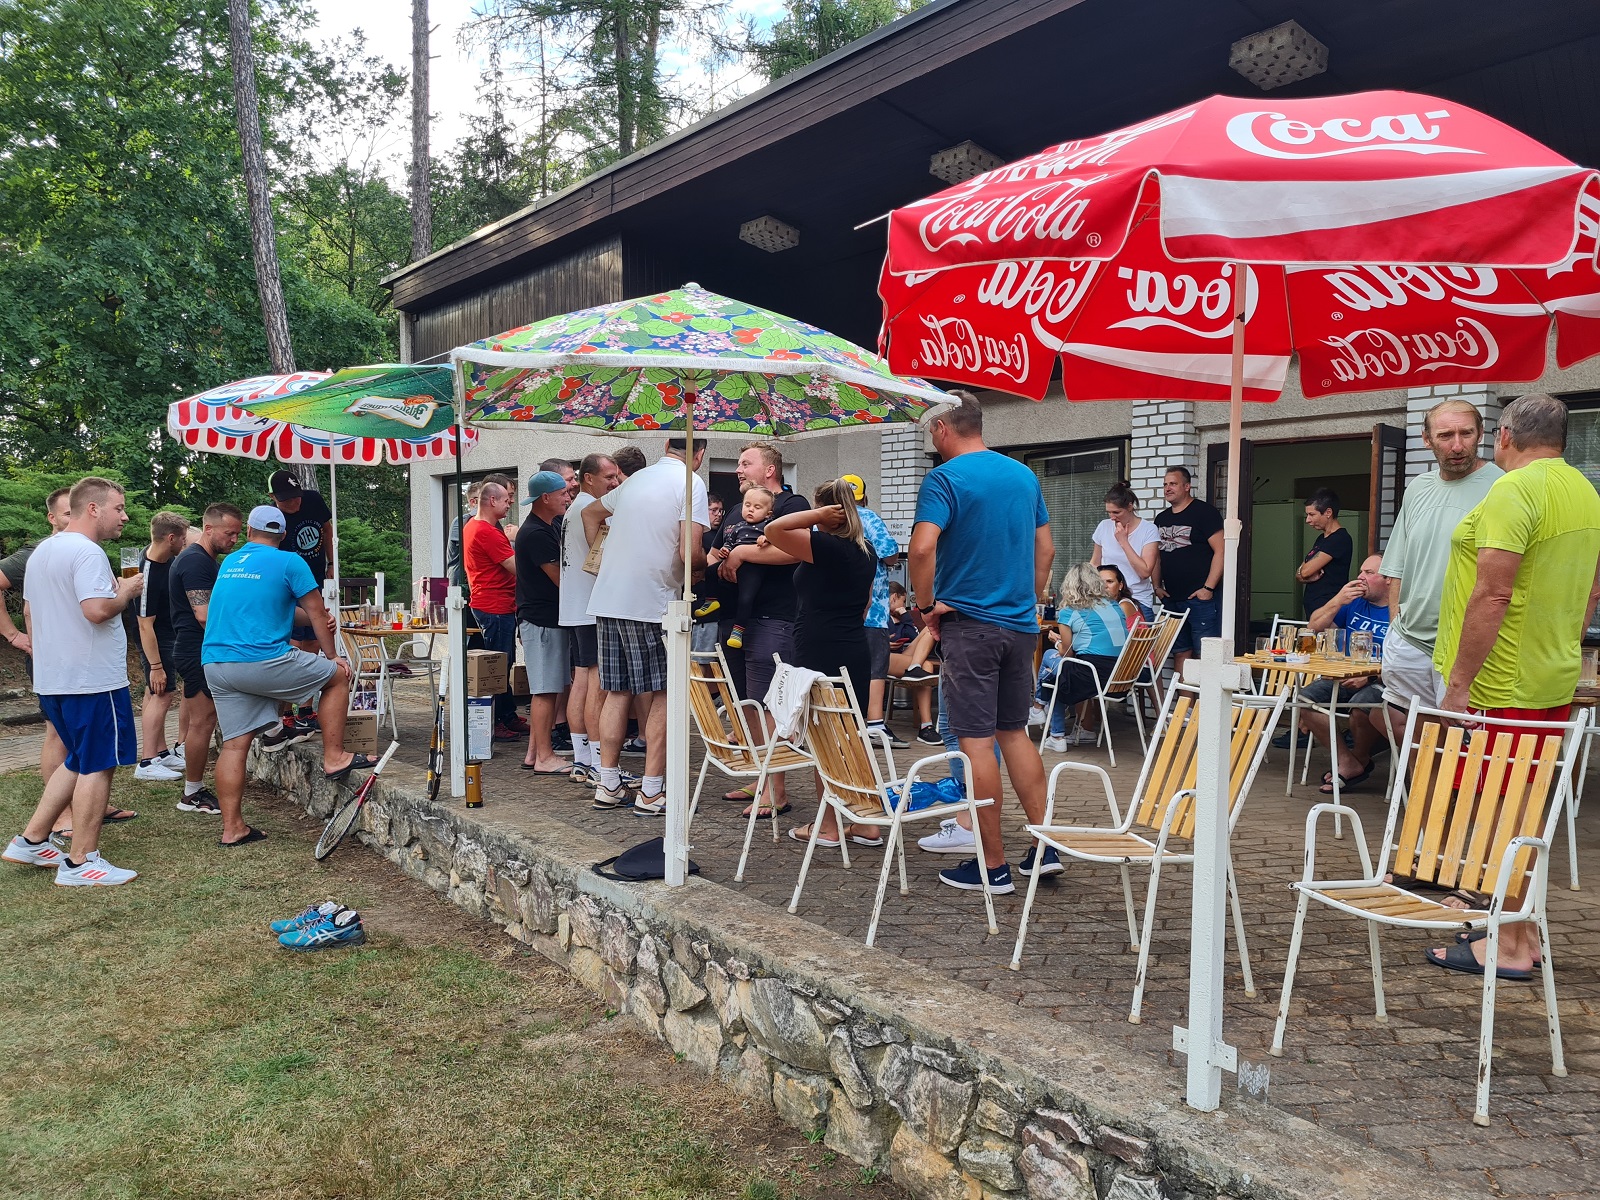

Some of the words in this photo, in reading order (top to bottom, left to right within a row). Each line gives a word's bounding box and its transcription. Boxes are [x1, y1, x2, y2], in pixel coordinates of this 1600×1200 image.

[1226, 109, 1488, 160] Coca-
[919, 173, 1111, 252] Coca-Cola
[298, 526, 319, 548] ATHL
[1350, 616, 1382, 634] FOX
